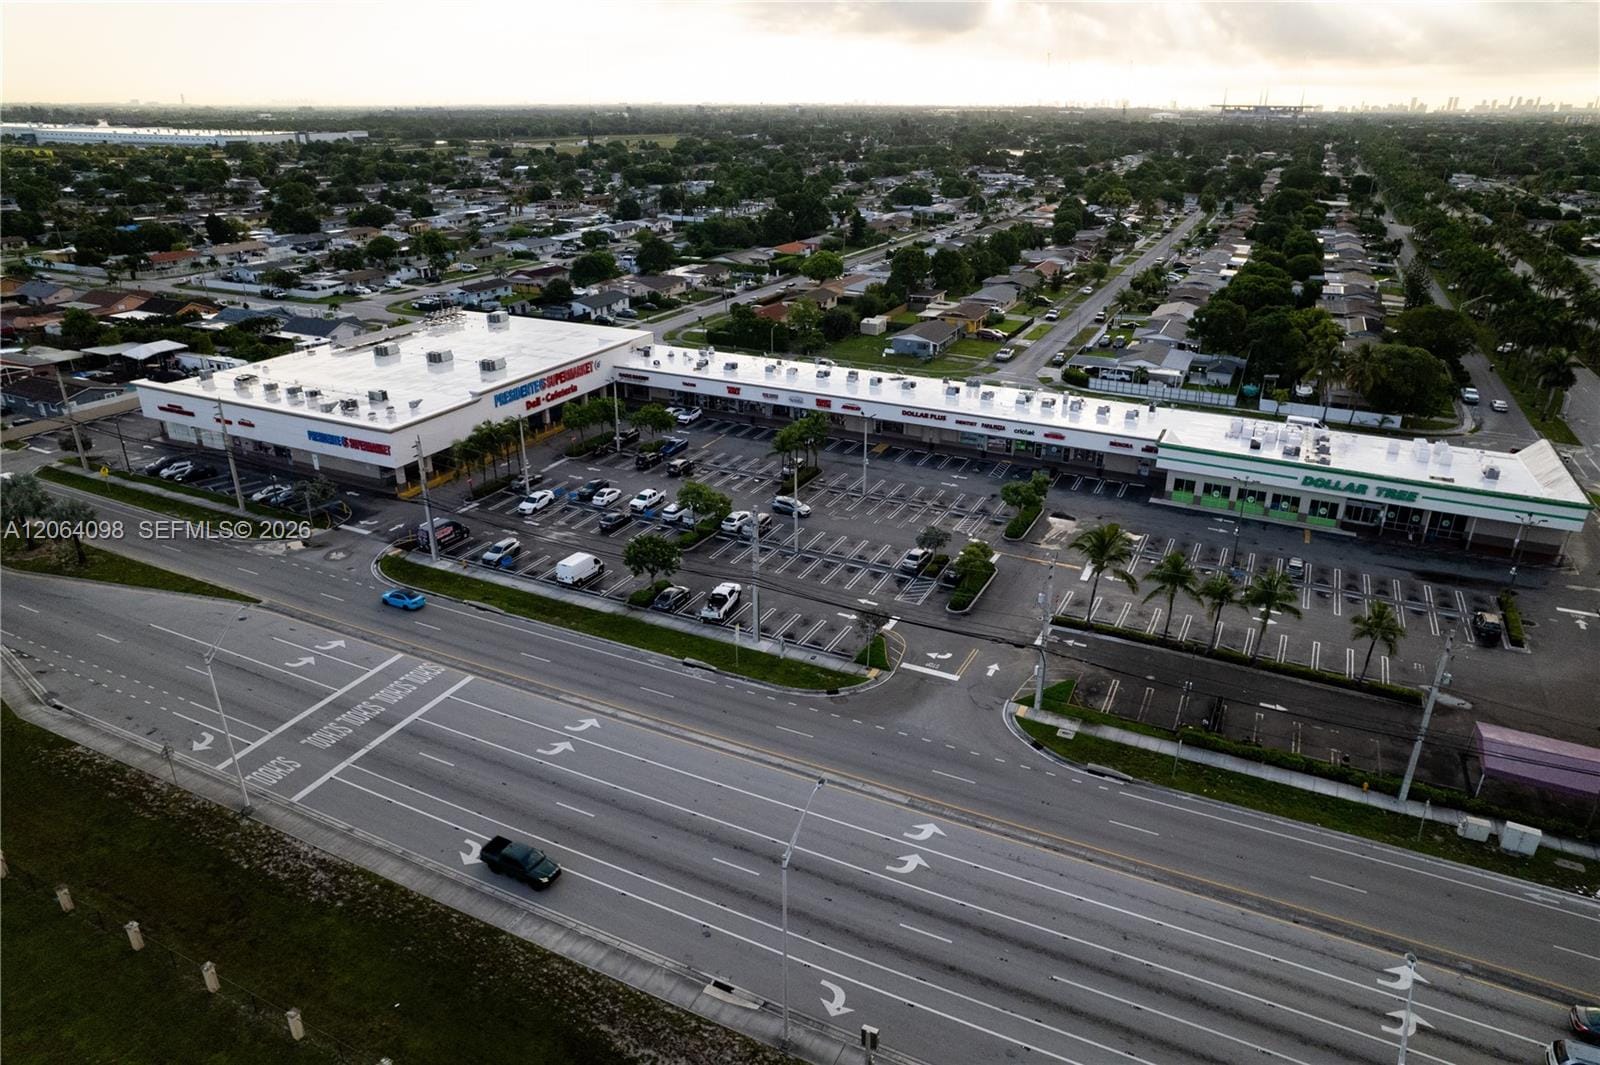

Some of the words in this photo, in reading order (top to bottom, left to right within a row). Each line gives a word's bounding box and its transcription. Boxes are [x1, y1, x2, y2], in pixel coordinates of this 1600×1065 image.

[545, 360, 594, 388] SUPERMARKET
[901, 409, 929, 420] DOLLAR
[929, 414, 946, 422] PLUS
[1301, 475, 1368, 495] DOLLAR
[1375, 485, 1419, 502] TREE
[400, 662, 446, 686] SCHOOL
[369, 678, 418, 705] SCHOOL
[335, 701, 386, 726] SCHOOL
[299, 722, 353, 750] SCHOOL
[244, 756, 302, 786] SCHOOL
